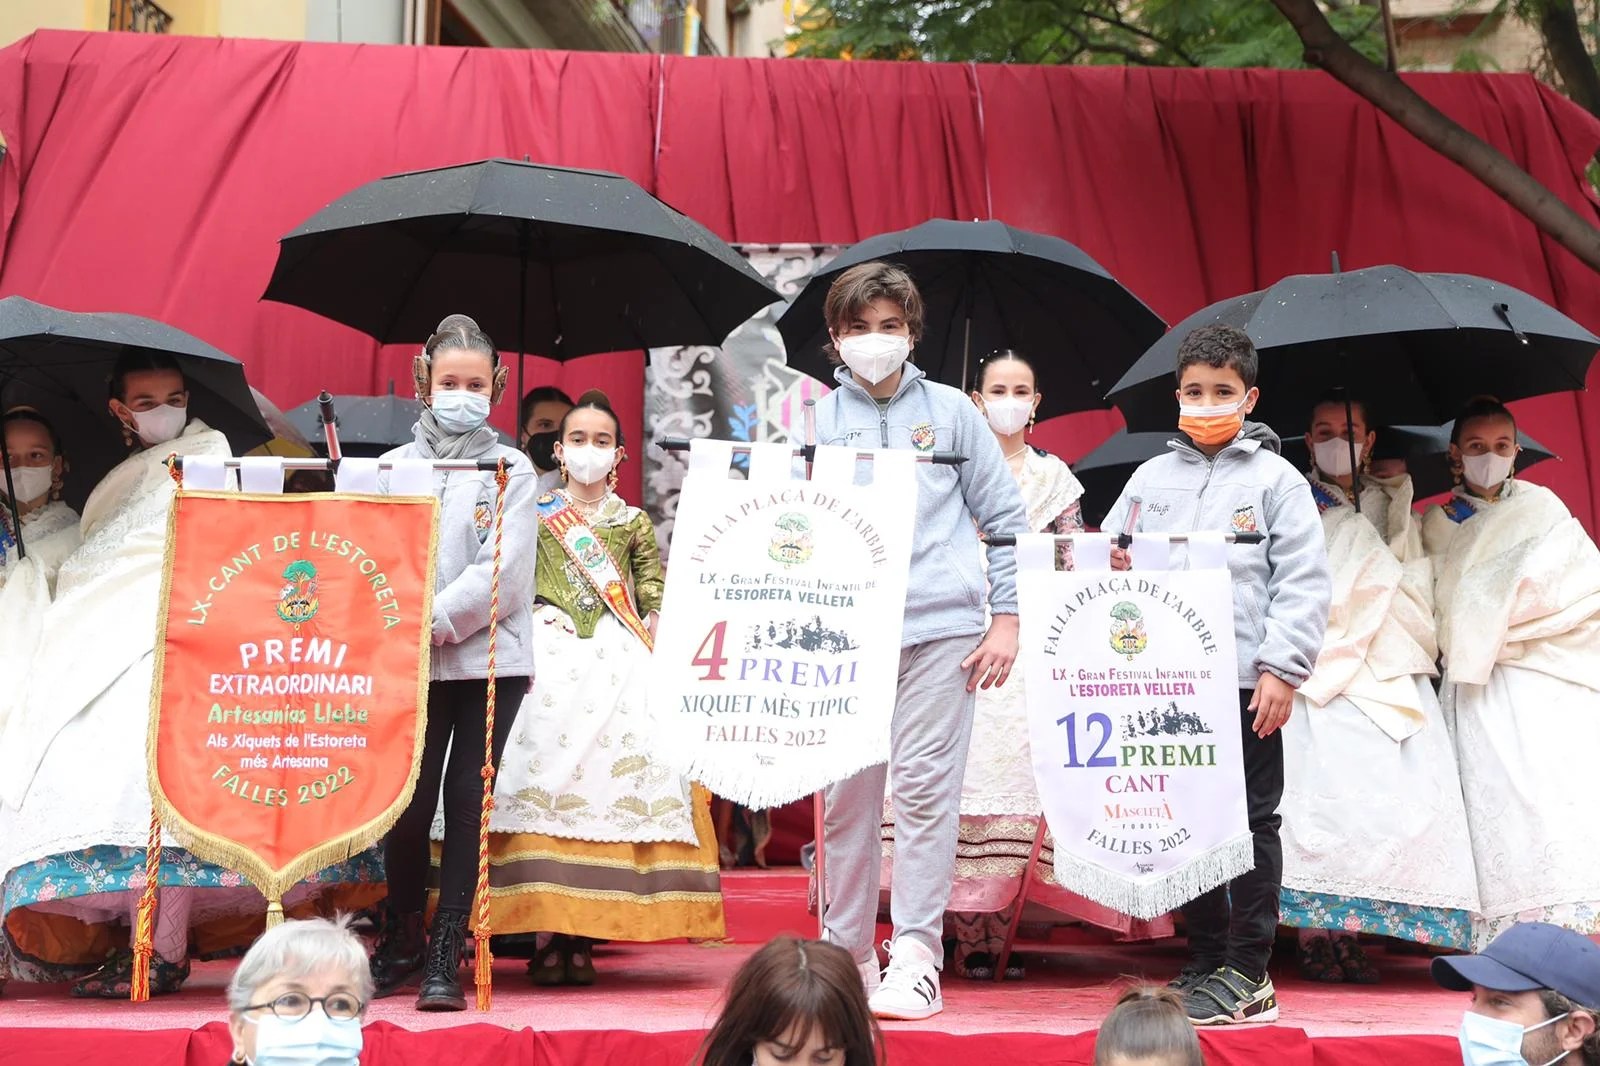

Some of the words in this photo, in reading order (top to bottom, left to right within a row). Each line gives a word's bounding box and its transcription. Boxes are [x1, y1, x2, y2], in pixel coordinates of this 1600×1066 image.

[690, 514, 738, 563] FALLA
[740, 489, 805, 517] PLAÇA
[812, 492, 841, 513] DE
[840, 507, 888, 569] L'ARBRE
[273, 531, 301, 553] DE
[310, 530, 401, 629] L'ESTORETA
[699, 573, 717, 585] LX
[714, 588, 792, 601] L'ESTORETA
[798, 591, 854, 608] VELLETA
[1043, 602, 1077, 656] FALLA
[1075, 577, 1132, 606] PLAÇA
[1138, 579, 1160, 599] DE
[1162, 591, 1218, 656] L'ARBRE
[239, 637, 347, 668] PREMI
[691, 620, 728, 681] 4
[738, 657, 859, 688] PREMI
[209, 674, 373, 696] EXTRAORDINARI
[1052, 668, 1067, 681] LX
[1069, 683, 1141, 697] L'ESTORETA
[1144, 682, 1196, 696] VELLETA
[314, 702, 369, 724] Llobe
[680, 694, 756, 718] XIQUET
[206, 733, 228, 748] Als
[232, 734, 281, 751] Xiquets
[285, 734, 299, 747] de
[304, 733, 367, 748] l'Estoreta
[704, 724, 778, 744] FALLES
[784, 728, 827, 747] 2022
[1056, 711, 1117, 768] 12
[1120, 744, 1217, 767] PREMI
[240, 753, 268, 768] més
[272, 755, 329, 768] Artesana
[211, 764, 289, 807] FALLES
[297, 765, 356, 805] 2022
[1105, 774, 1170, 794] CANT
[1086, 828, 1153, 855] FALLES
[1158, 827, 1191, 852] 2022
